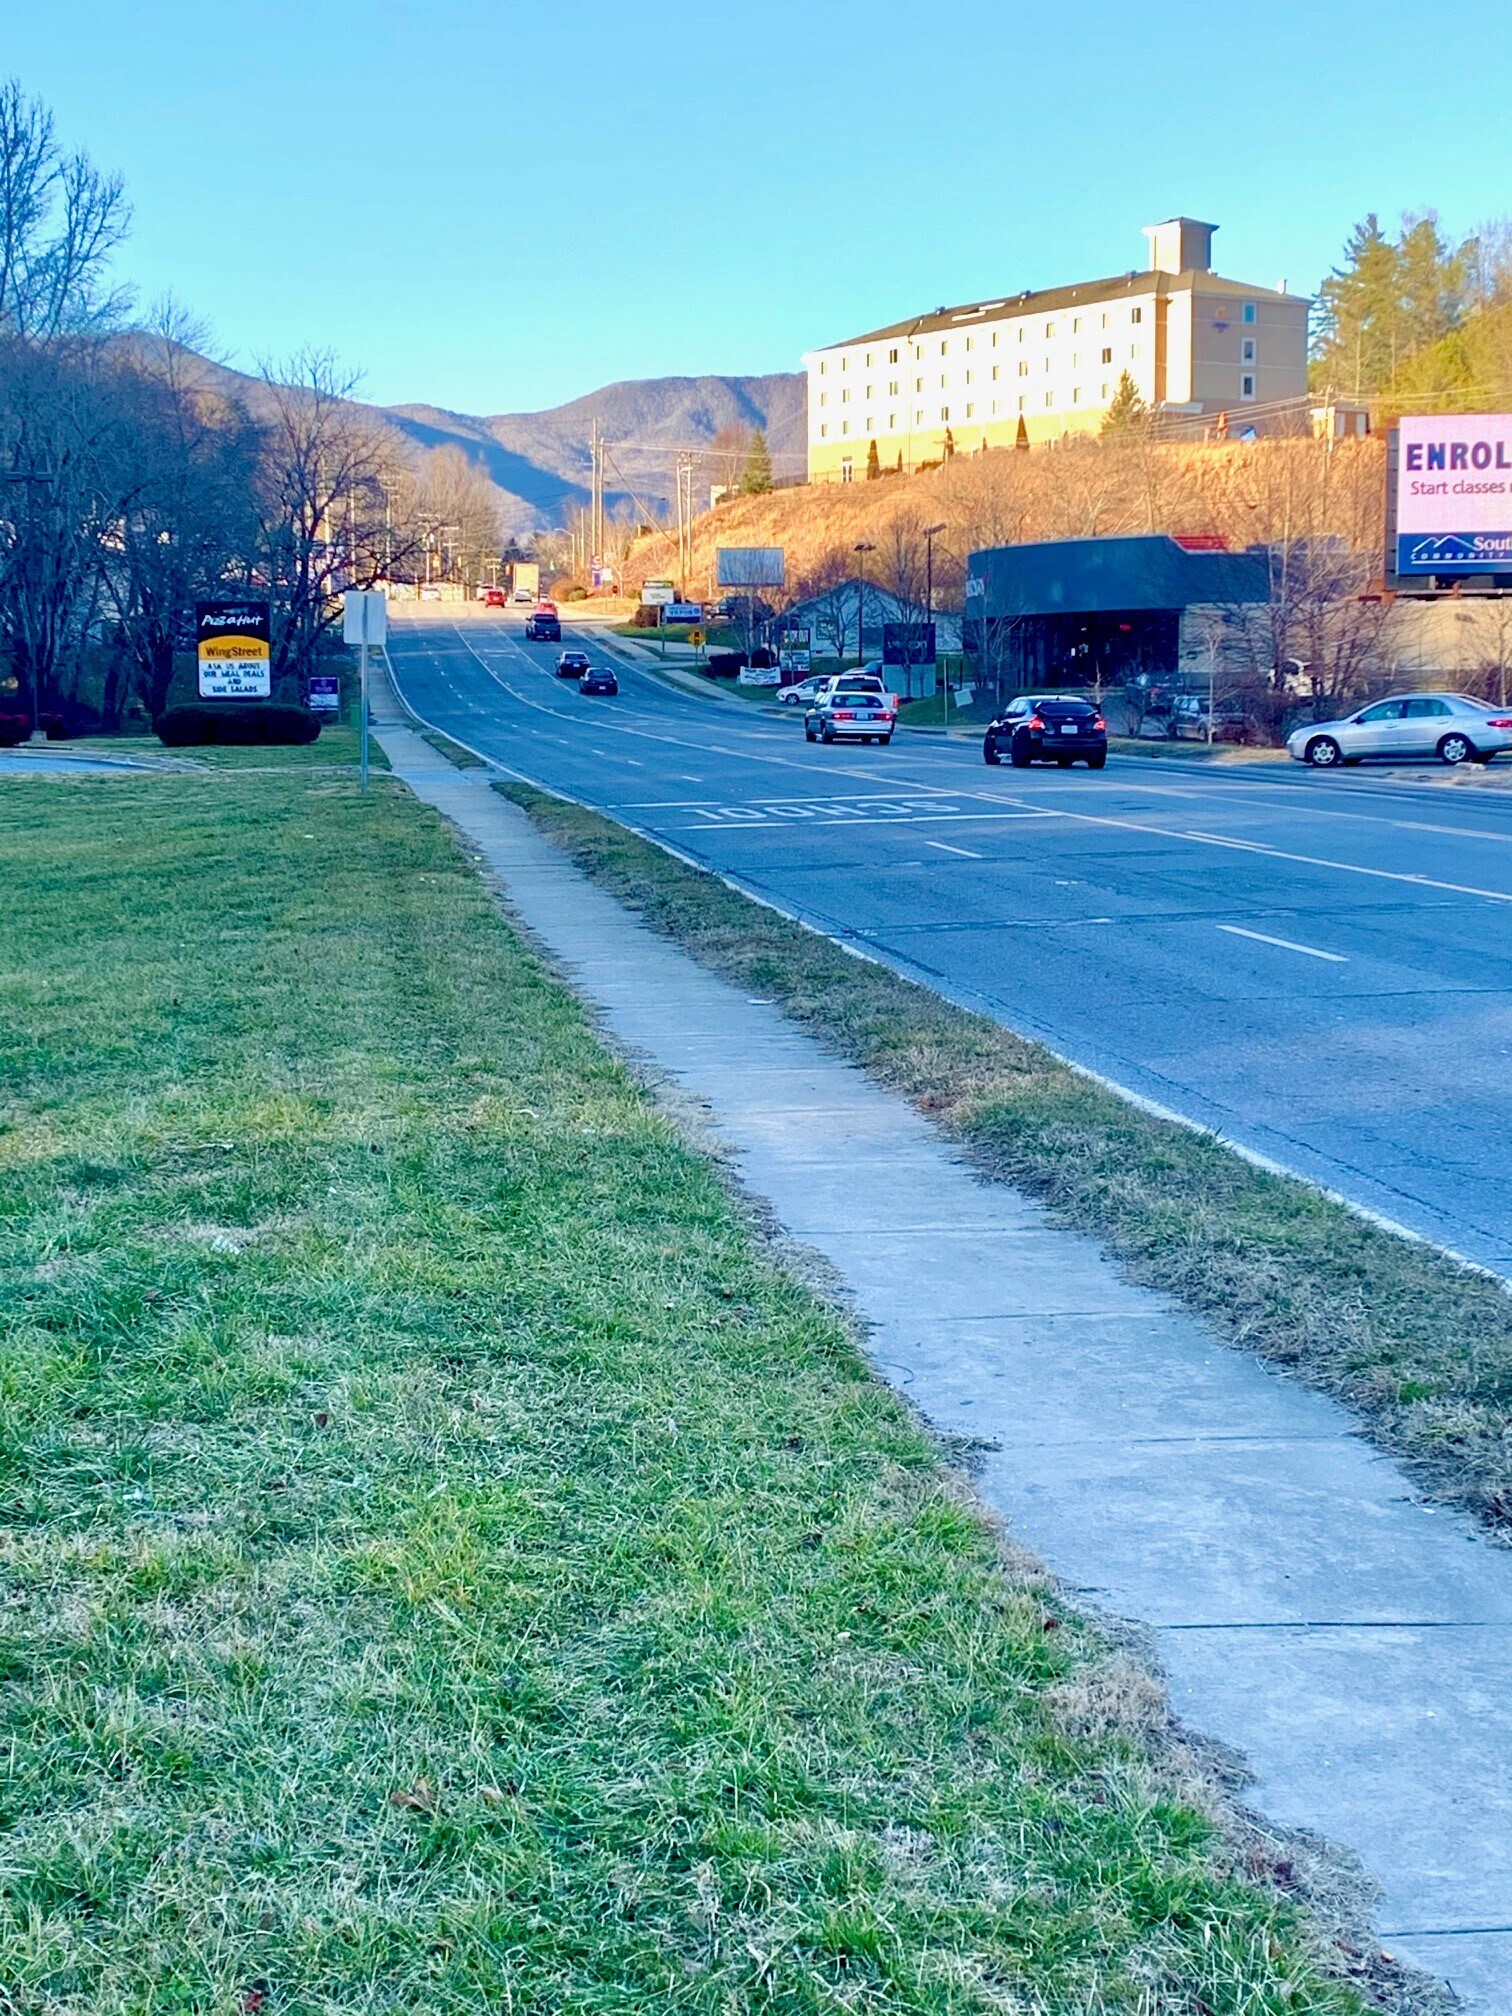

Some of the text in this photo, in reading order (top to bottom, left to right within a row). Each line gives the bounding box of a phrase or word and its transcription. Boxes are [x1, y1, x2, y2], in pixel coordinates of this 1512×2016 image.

[1410, 480, 1449, 495] Start
[1453, 479, 1506, 494] classes
[205, 647, 262, 658] WingStreet
[680, 801, 961, 821] SCHOOL
